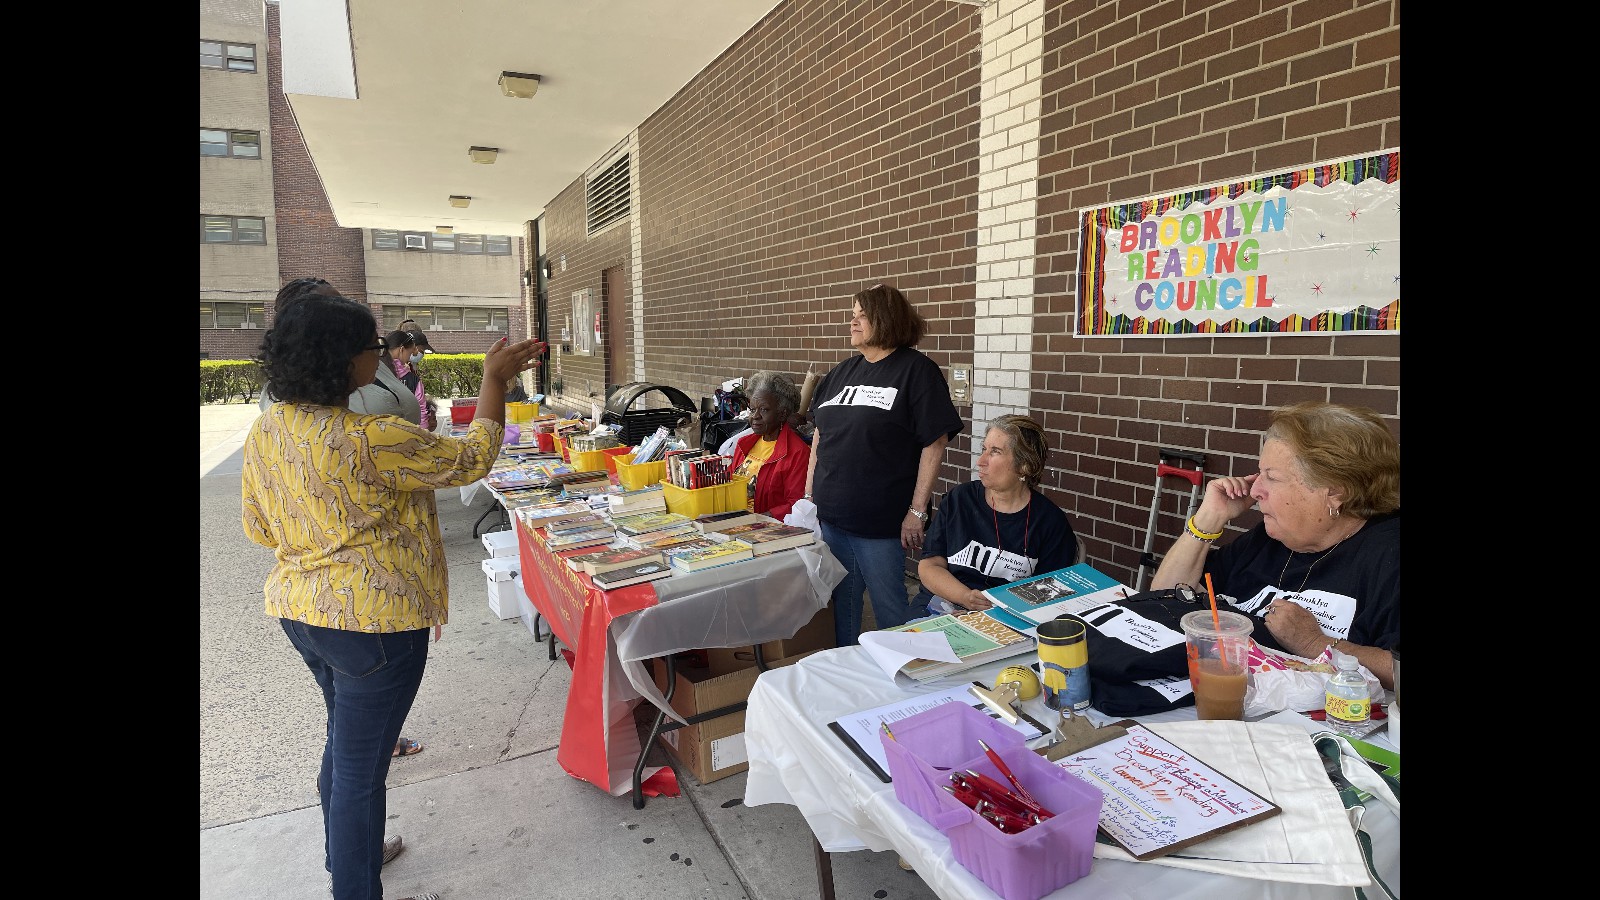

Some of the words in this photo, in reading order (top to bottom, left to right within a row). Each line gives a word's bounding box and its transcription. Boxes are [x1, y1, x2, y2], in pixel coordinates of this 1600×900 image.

[1119, 196, 1287, 254] BROOKLYN
[1127, 238, 1260, 282] READING
[1134, 275, 1273, 312] COUNCIL
[1292, 593, 1329, 608] Brooklyn
[1127, 735, 1187, 763] Support
[1115, 747, 1172, 786] Brooklyn
[1174, 783, 1219, 817] Reading
